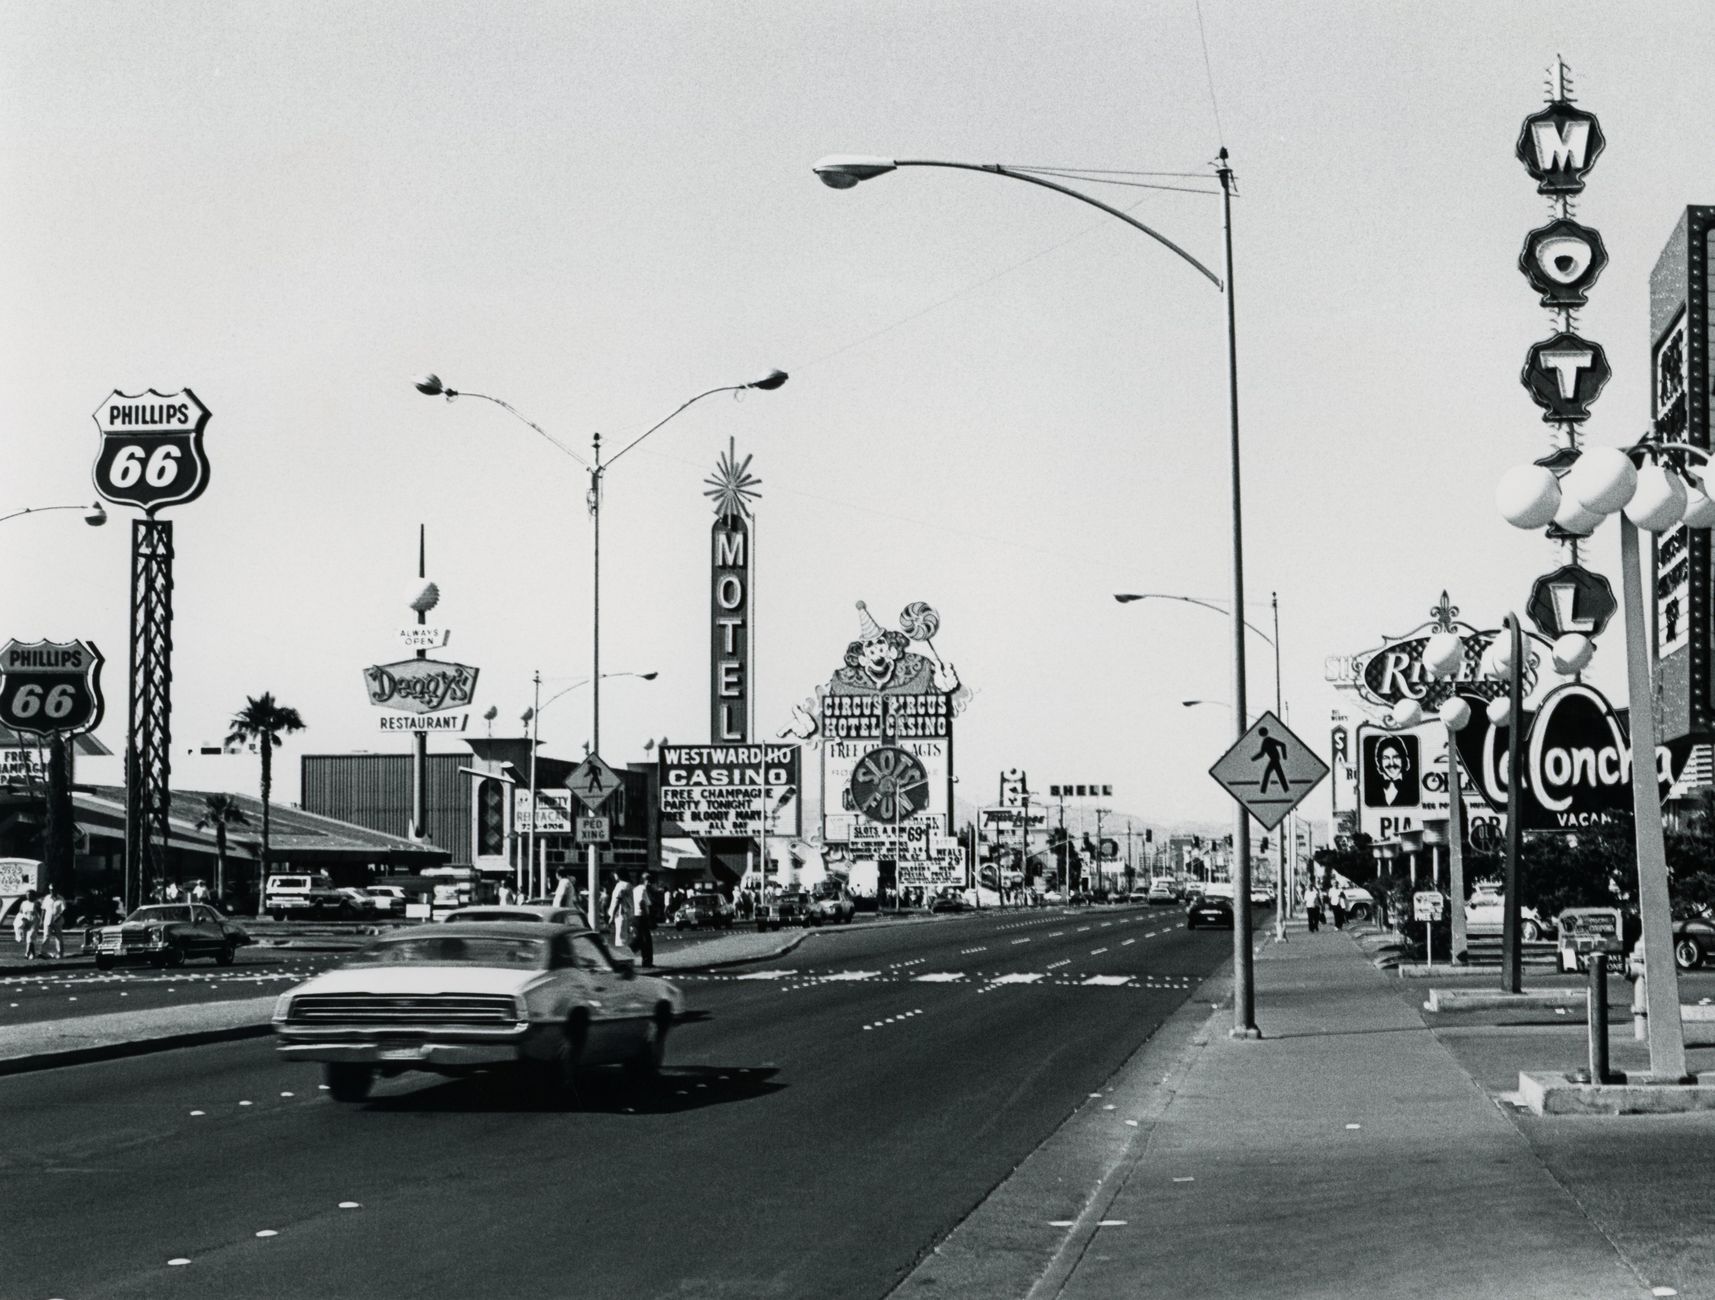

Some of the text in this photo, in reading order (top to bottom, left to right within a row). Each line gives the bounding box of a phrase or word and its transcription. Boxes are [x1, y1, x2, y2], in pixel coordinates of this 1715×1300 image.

[1531, 120, 1597, 633] MOTL
[109, 403, 188, 425] PHILLIPS
[109, 444, 181, 488] 66
[714, 529, 744, 740] MOTEL
[10, 650, 82, 667] PHILLIPS
[368, 665, 468, 709] Denny's
[11, 684, 76, 718] 66
[824, 697, 881, 716] CIRCUS
[380, 717, 458, 729] RESTAURANT
[824, 717, 947, 737] HOTEL CASINO
[664, 747, 791, 765] WESTWARD HO
[1529, 683, 1676, 811] Concha
[668, 768, 788, 786] CASINO
[663, 789, 694, 800] FREE
[1050, 785, 1113, 796] SHELL
[663, 801, 753, 811] PARTY TONIGHT
[583, 820, 603, 829] PED
[690, 811, 730, 821] BLOODY
[581, 830, 606, 839] XING
